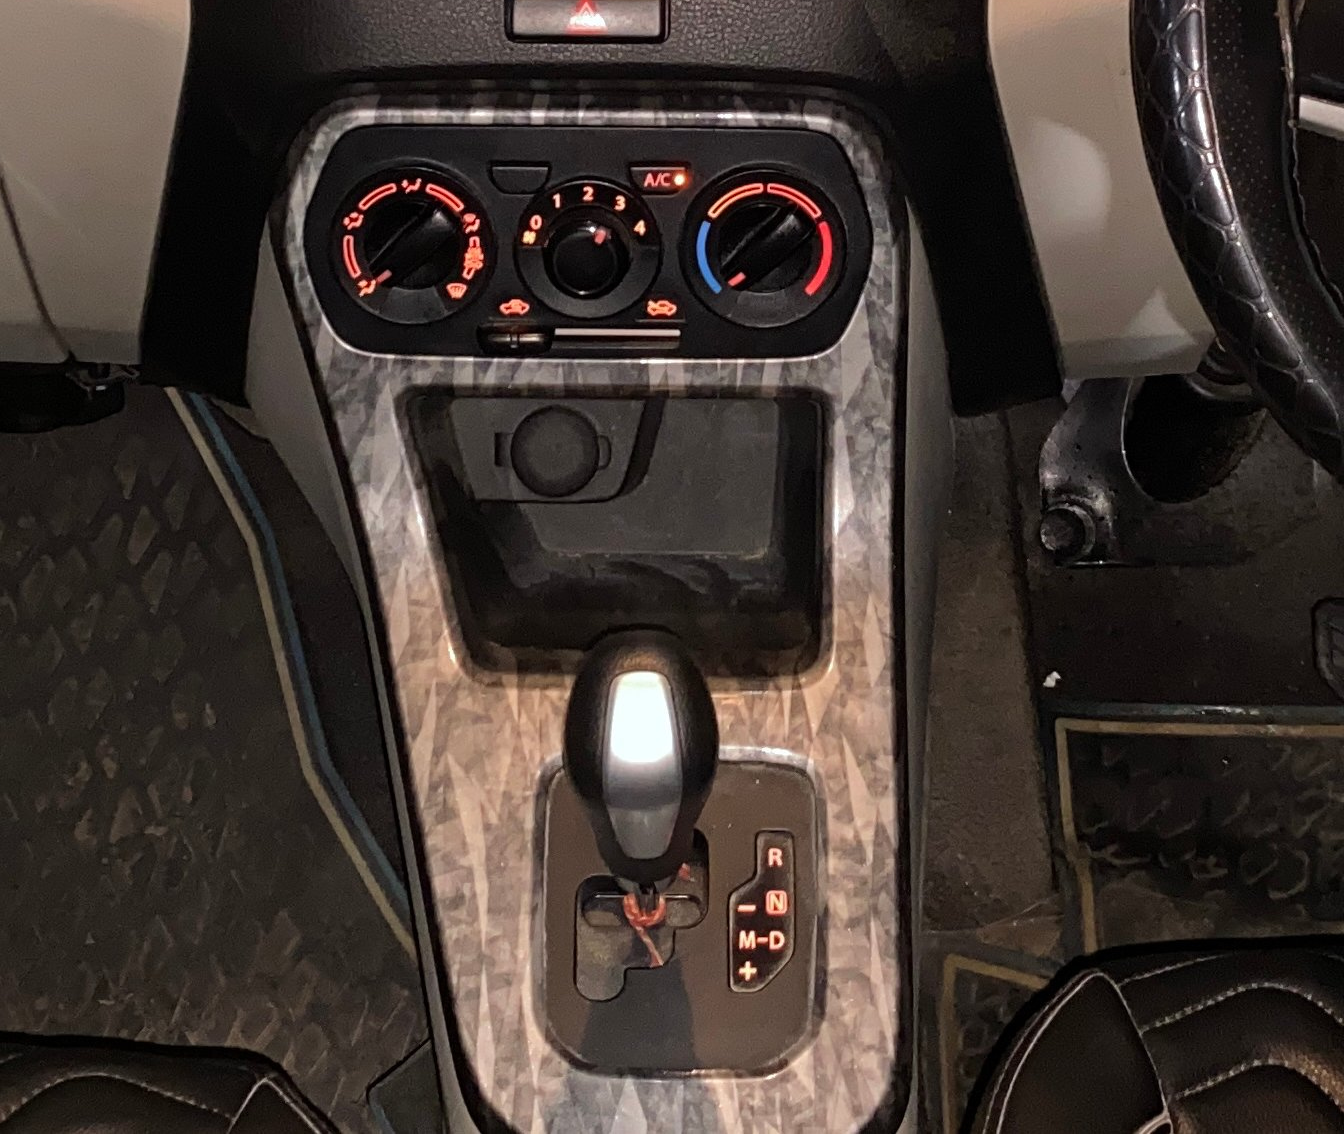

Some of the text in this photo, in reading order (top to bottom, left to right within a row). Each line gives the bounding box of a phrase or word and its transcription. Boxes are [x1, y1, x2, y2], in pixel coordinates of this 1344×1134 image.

[644, 173, 670, 187] A/C
[552, 193, 561, 208] 1
[582, 186, 594, 202] 2
[614, 195, 626, 211] 3
[529, 215, 543, 230] 0
[634, 219, 646, 236] 4
[768, 848, 783, 866] R
